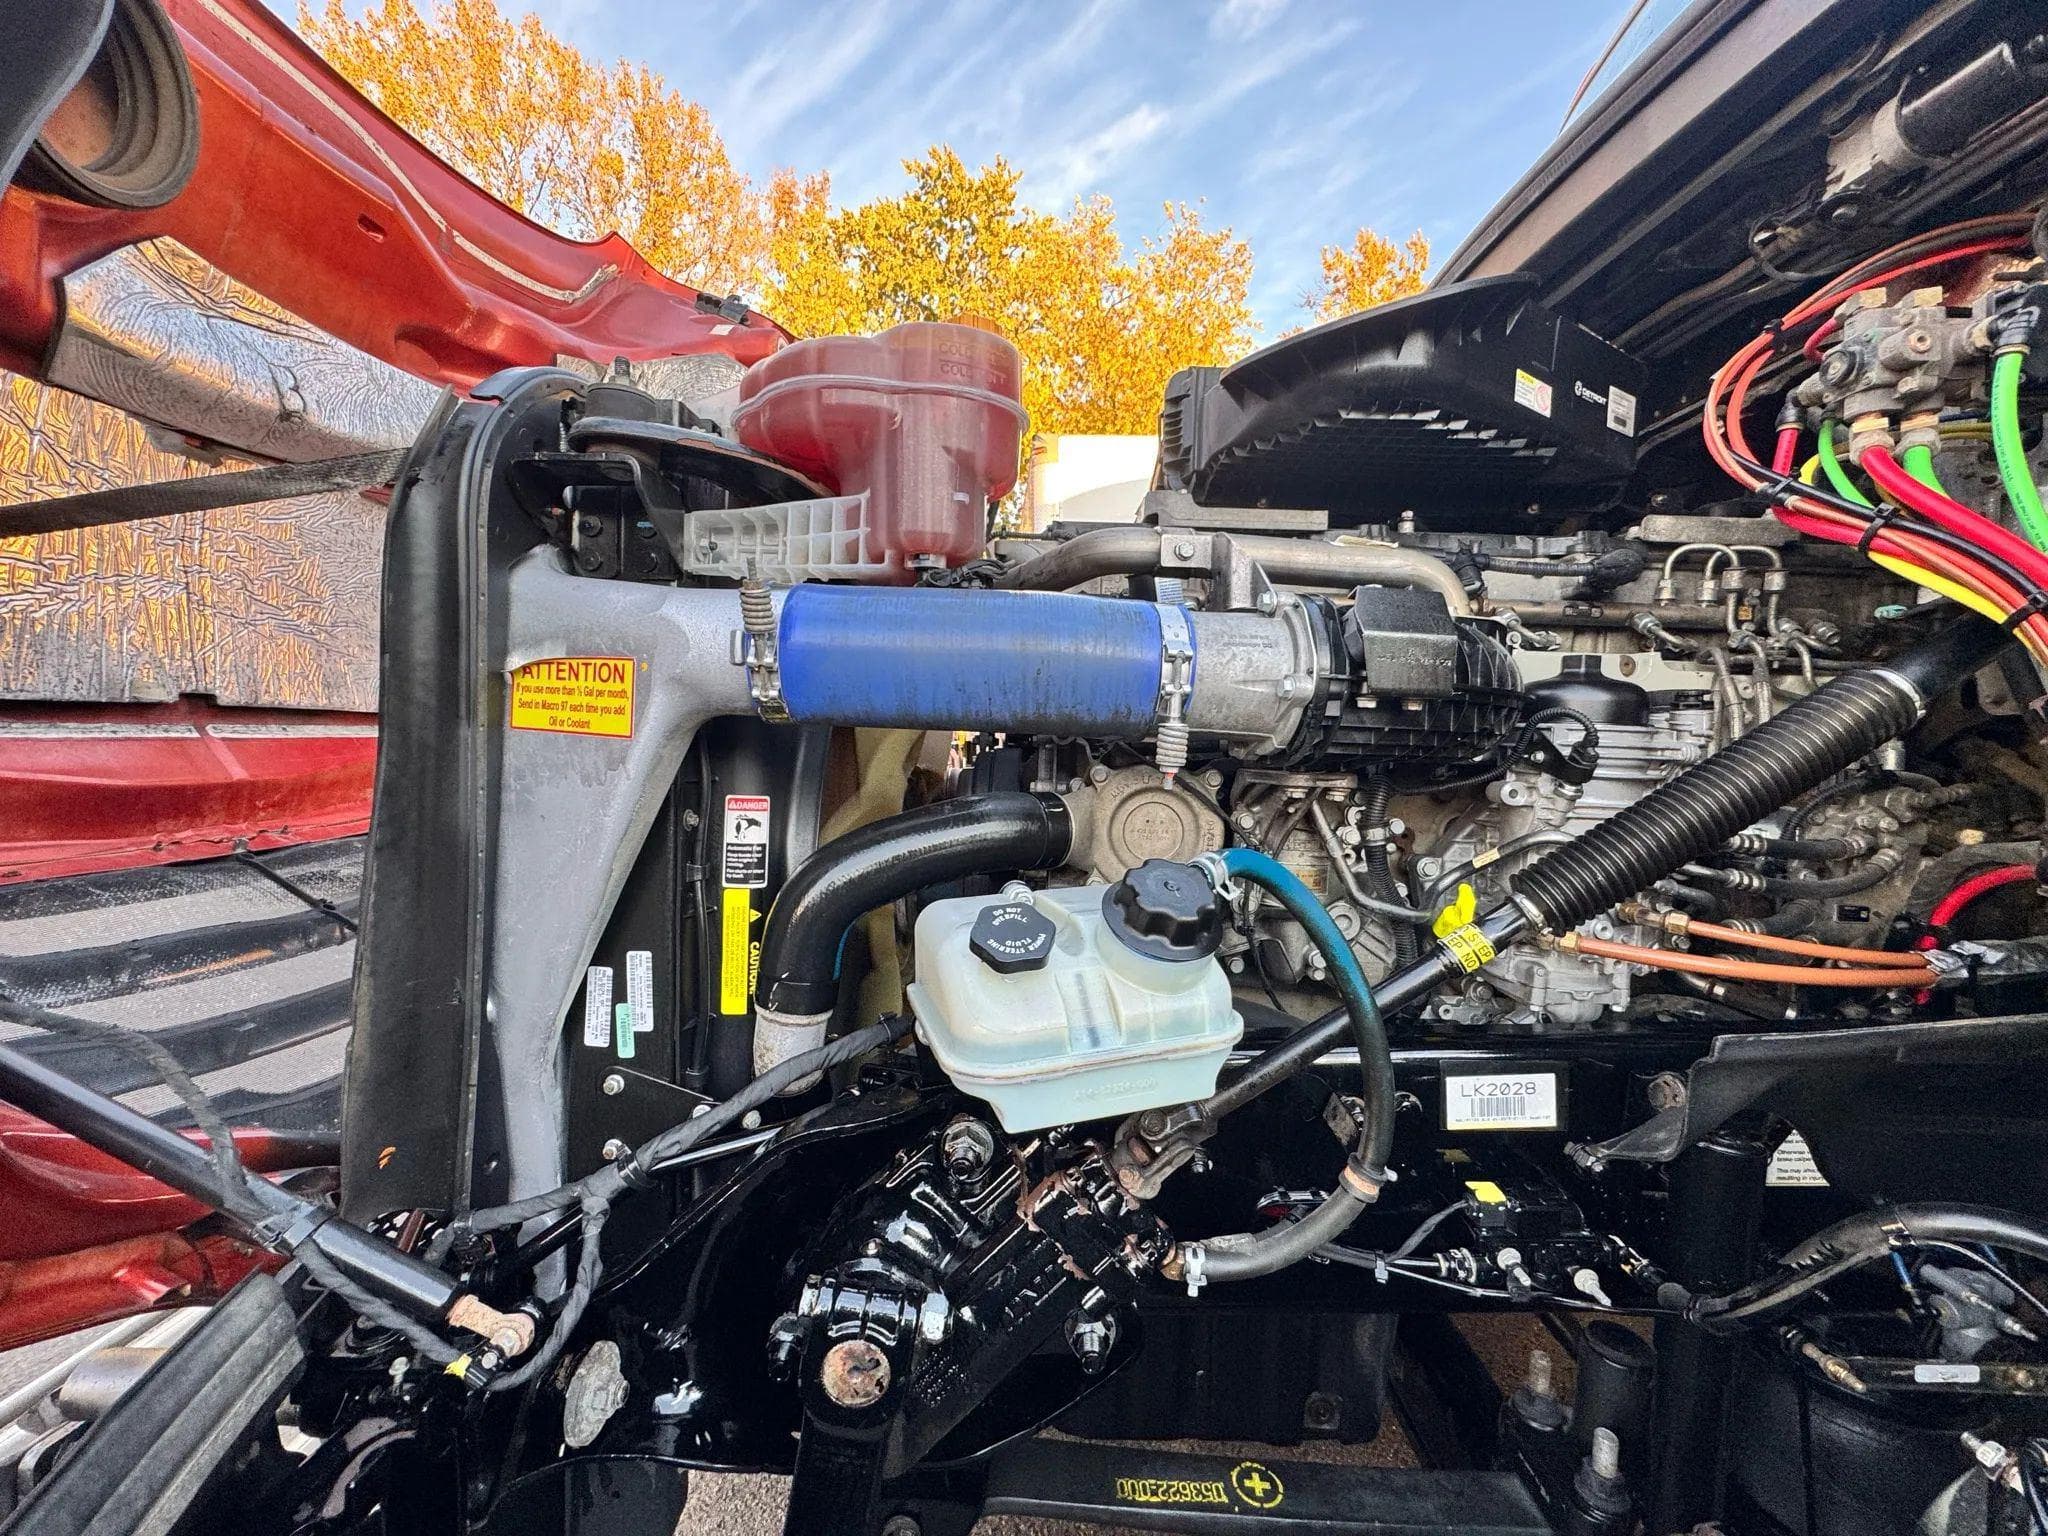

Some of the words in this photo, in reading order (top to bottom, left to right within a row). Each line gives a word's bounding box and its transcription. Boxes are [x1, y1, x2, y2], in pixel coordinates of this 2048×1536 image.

[521, 662, 625, 684] ATTENTION
[520, 685, 532, 695] you
[533, 686, 544, 694] use
[562, 686, 575, 695] than
[583, 686, 594, 697] Gal
[596, 688, 607, 699] per
[518, 698, 533, 709] Send
[533, 700, 540, 709] in
[541, 701, 559, 711] Macro
[569, 702, 584, 712] each
[585, 703, 599, 713] time
[600, 706, 611, 717] you
[613, 704, 626, 715] add
[549, 716, 558, 726] Oil
[558, 718, 565, 727] or
[736, 801, 768, 810] DANGER
[992, 908, 1004, 917] DO
[992, 913, 1029, 926] OVERFILL
[986, 938, 1026, 954] STEERING
[1462, 952, 1477, 968] NO
[1460, 1081, 1537, 1097] LK2028
